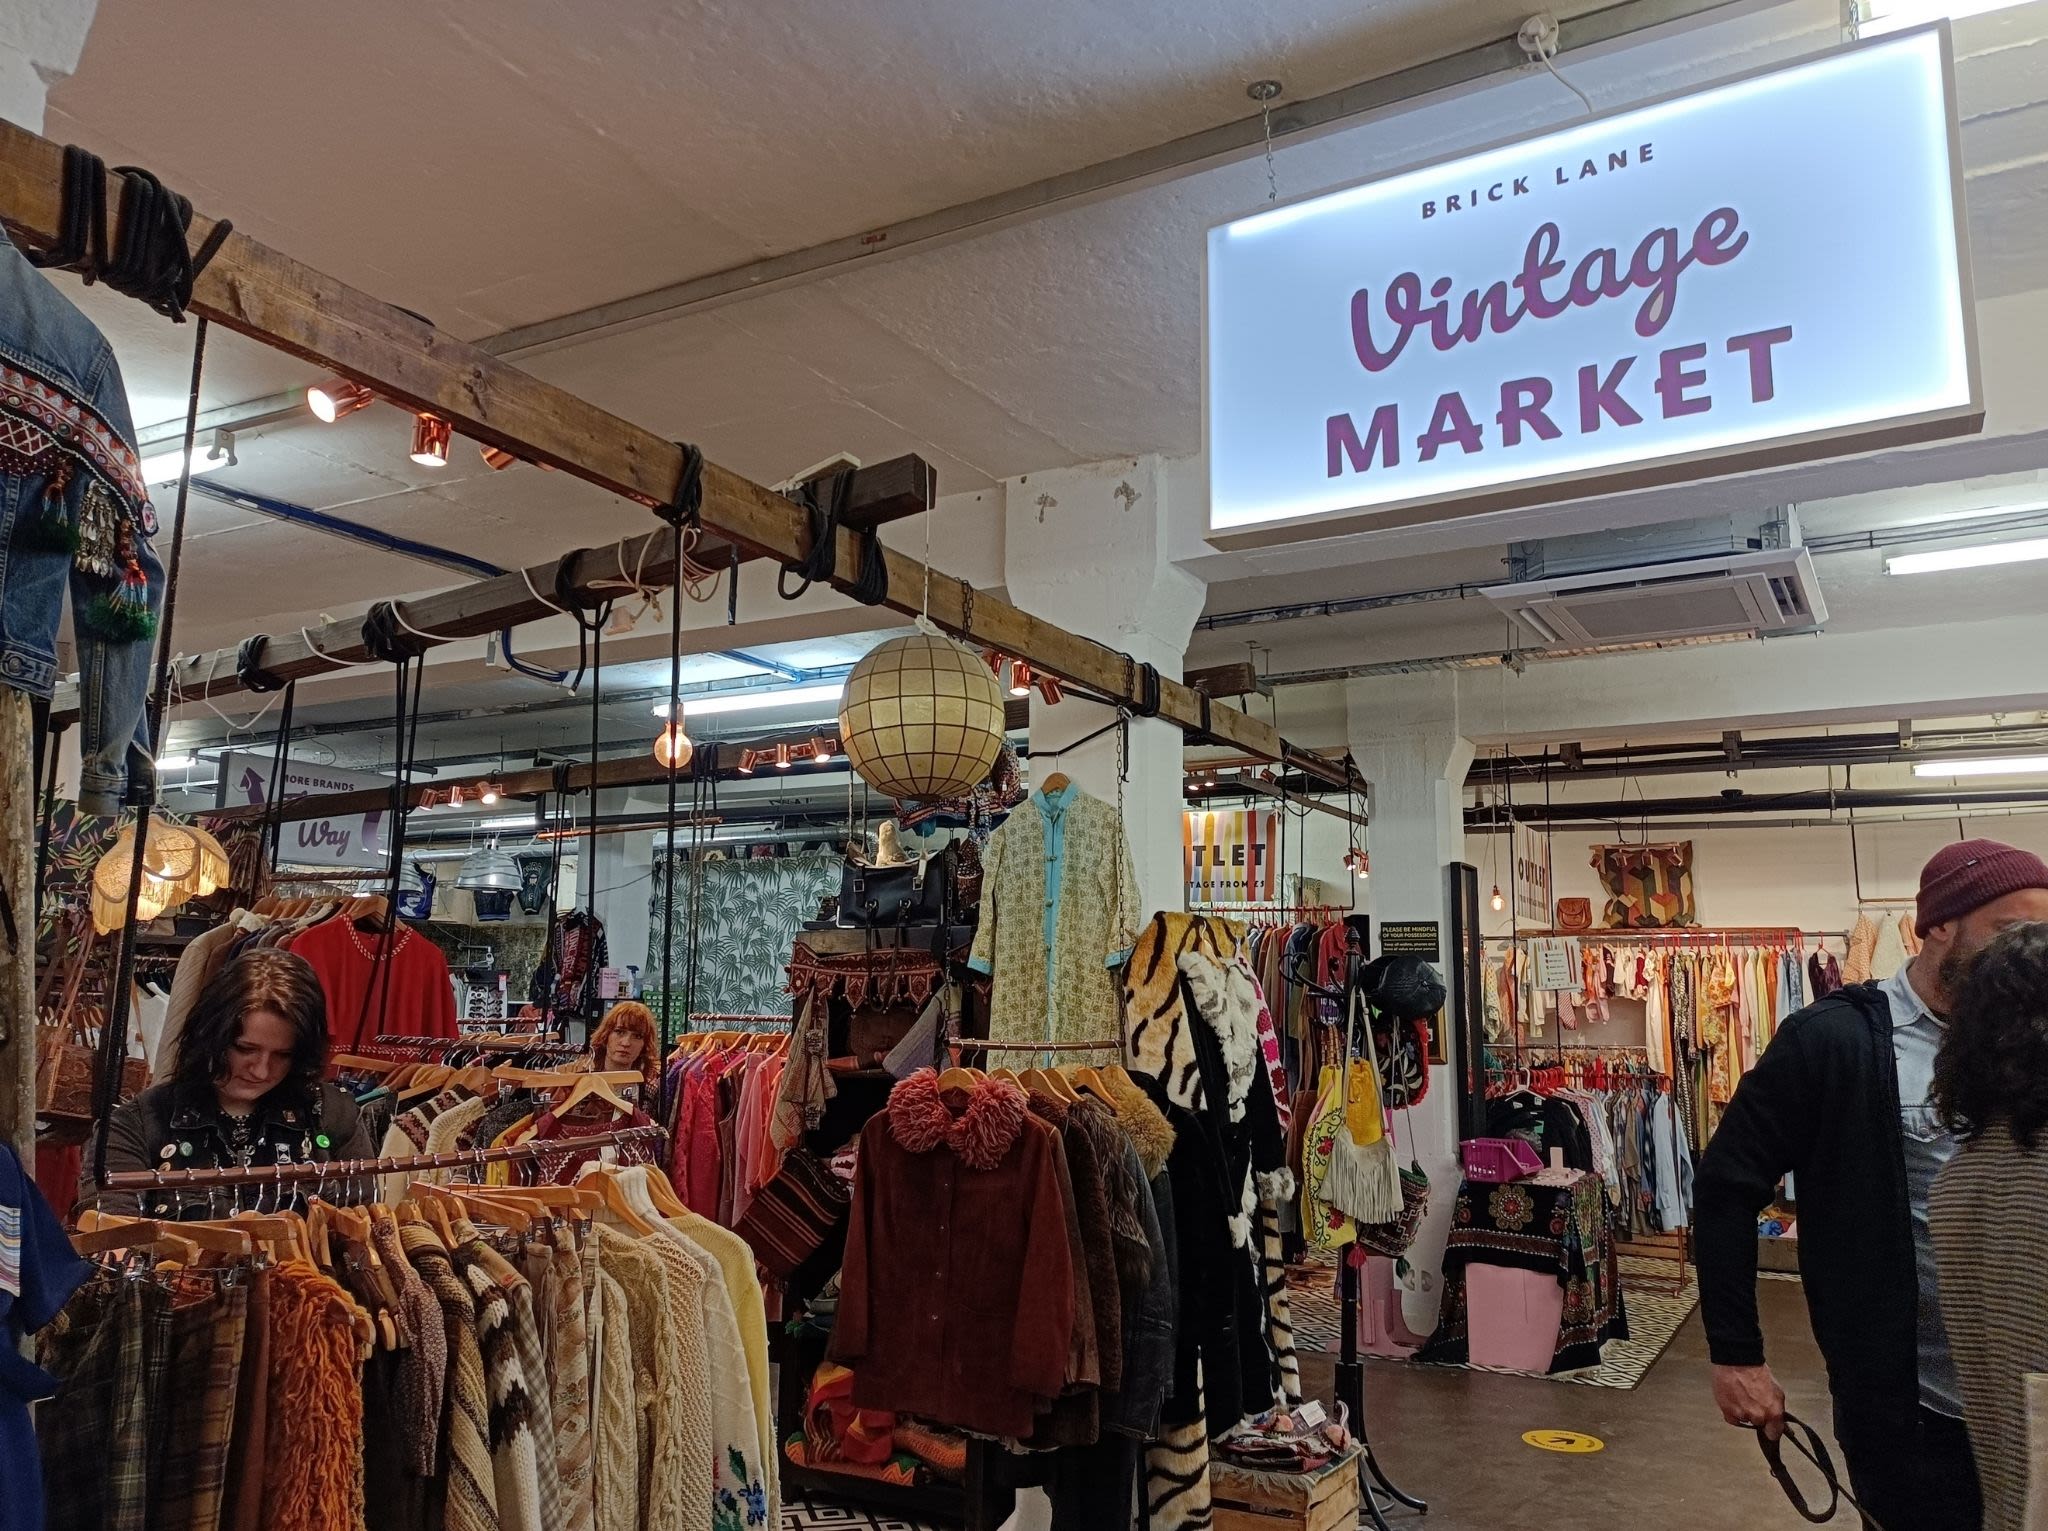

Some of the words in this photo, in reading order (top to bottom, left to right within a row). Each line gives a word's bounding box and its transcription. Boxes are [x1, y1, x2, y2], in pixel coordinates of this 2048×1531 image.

[1421, 176, 1531, 220] BRICK
[1555, 142, 1658, 185] LANE
[1349, 206, 1750, 374] Vintage
[1326, 325, 1794, 479] MARKET
[313, 778, 355, 792] BRANDS
[298, 820, 350, 858] Way
[1183, 843, 1266, 867] TLET
[1186, 880, 1216, 889] TAGE
[1220, 880, 1249, 889] FROM
[1518, 856, 1546, 889] OUTLET
